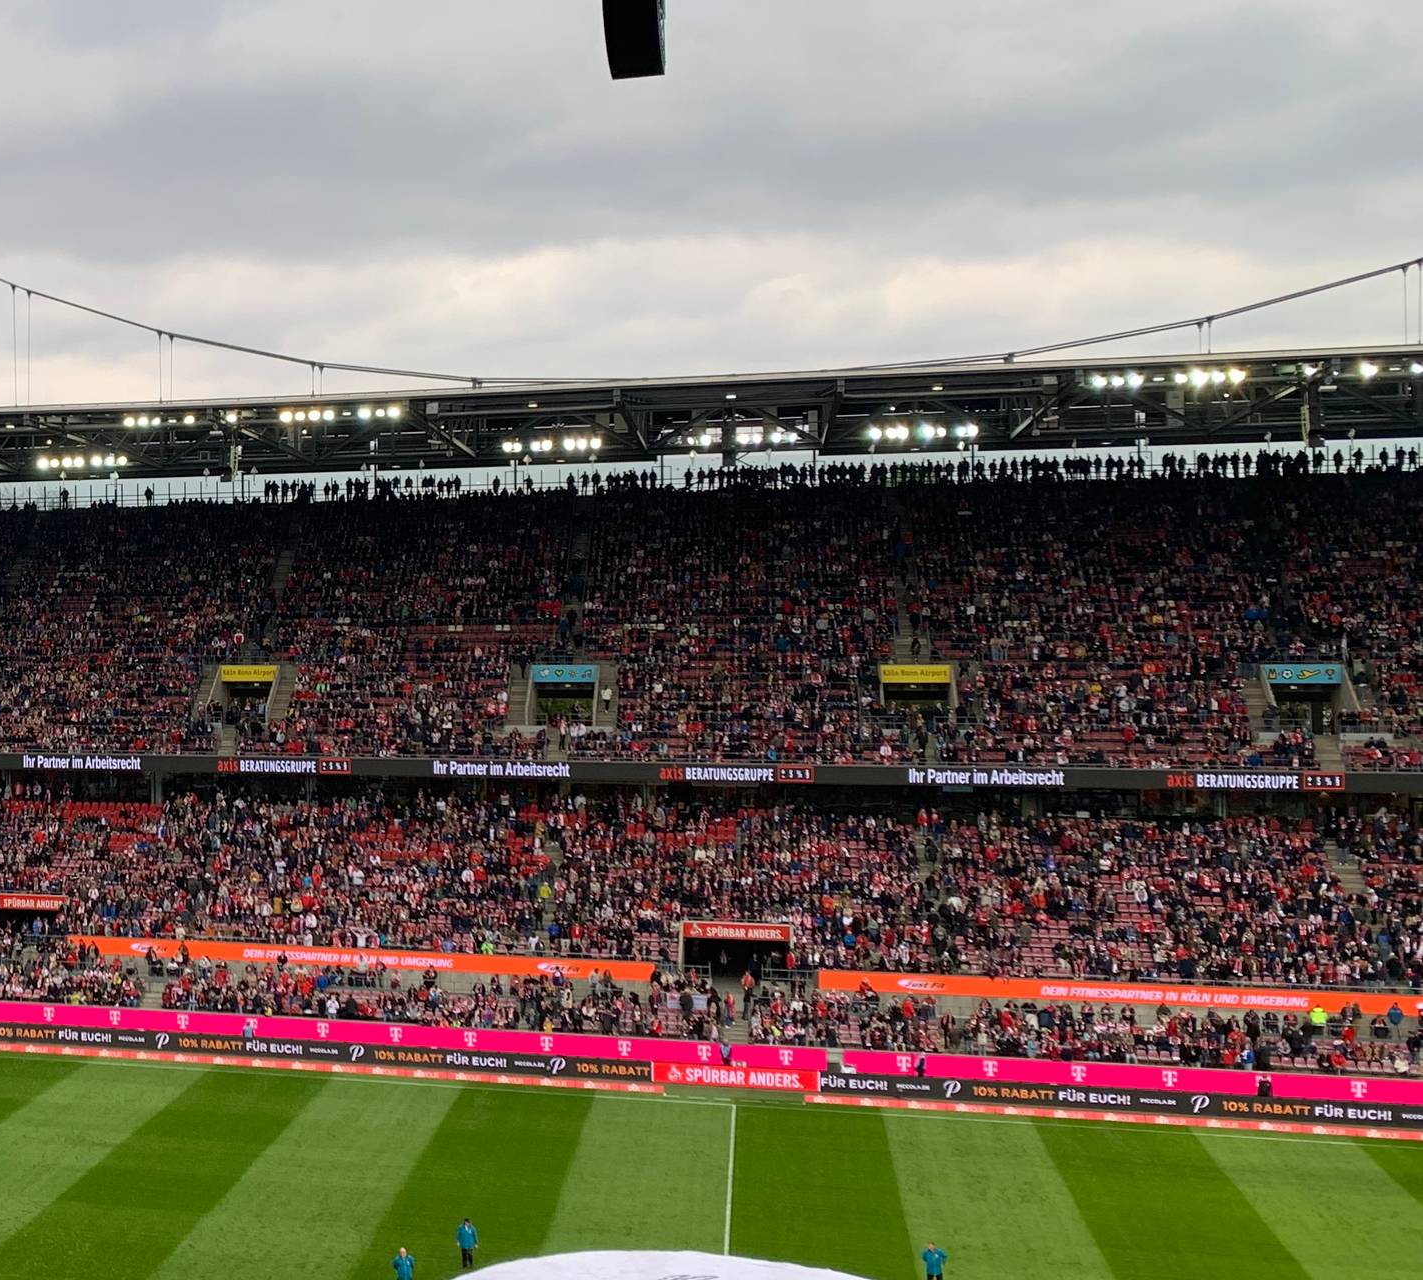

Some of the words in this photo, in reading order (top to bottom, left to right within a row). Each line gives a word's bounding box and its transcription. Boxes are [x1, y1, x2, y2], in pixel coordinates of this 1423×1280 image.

[23, 754, 36, 768] Ihr
[37, 755, 70, 768] Partner
[72, 755, 84, 769] im
[85, 756, 141, 770] Arbeitsrecht
[217, 760, 238, 773] axis
[240, 760, 316, 773] BERATUNGSGRUPPE
[433, 760, 447, 774] Ihr
[449, 761, 488, 775] Partner
[490, 762, 503, 776] im
[505, 762, 570, 777] Arbeitsrecht
[659, 768, 683, 780] axis
[685, 767, 774, 782] BERATUNGSGRUPPE
[908, 769, 925, 784] Ihr
[927, 769, 971, 785] Partner
[973, 770, 989, 785] im
[990, 770, 1065, 787] Arbeitsrecht
[1167, 773, 1195, 787] axis
[1196, 773, 1299, 789] BERATUNGSGRUPPE
[706, 925, 746, 938] SPÜRBAR
[1041, 986, 1068, 996] DEIN
[1069, 987, 1163, 1001] FITNESSPARTNER
[1165, 991, 1178, 1002] IN
[1180, 989, 1211, 1003] KÖLN
[1213, 993, 1240, 1004] UND
[1242, 994, 1309, 1007] UMGEBUNG
[16, 1028, 55, 1040] RABATT
[58, 1029, 78, 1041] FÜR
[81, 1032, 112, 1043] EUCH!
[179, 1037, 198, 1049] 10%
[200, 1039, 243, 1051] RABATT
[246, 1040, 267, 1053] FÜR
[270, 1043, 303, 1055] EUCH!
[374, 1050, 395, 1061] 10%
[397, 1051, 443, 1064] RABATT
[446, 1053, 468, 1066] FÜR
[471, 1056, 507, 1068] EUCH!
[577, 1063, 599, 1074] 10%
[602, 1064, 649, 1076] RABATT
[685, 1064, 746, 1084] SPÜRBAR
[749, 1070, 804, 1088] ANDERS.
[821, 1074, 846, 1090] FÜR
[849, 1078, 888, 1092] EUCH!
[973, 1086, 998, 1098] 10%
[1001, 1088, 1055, 1101] RABATT
[1059, 1088, 1085, 1104] FÜR
[1089, 1092, 1131, 1106] EUCH!
[1222, 1100, 1249, 1113] 10%
[1252, 1102, 1311, 1117] RABATT
[1314, 1104, 1343, 1118] FÜR
[1347, 1108, 1392, 1121] EUCH!
